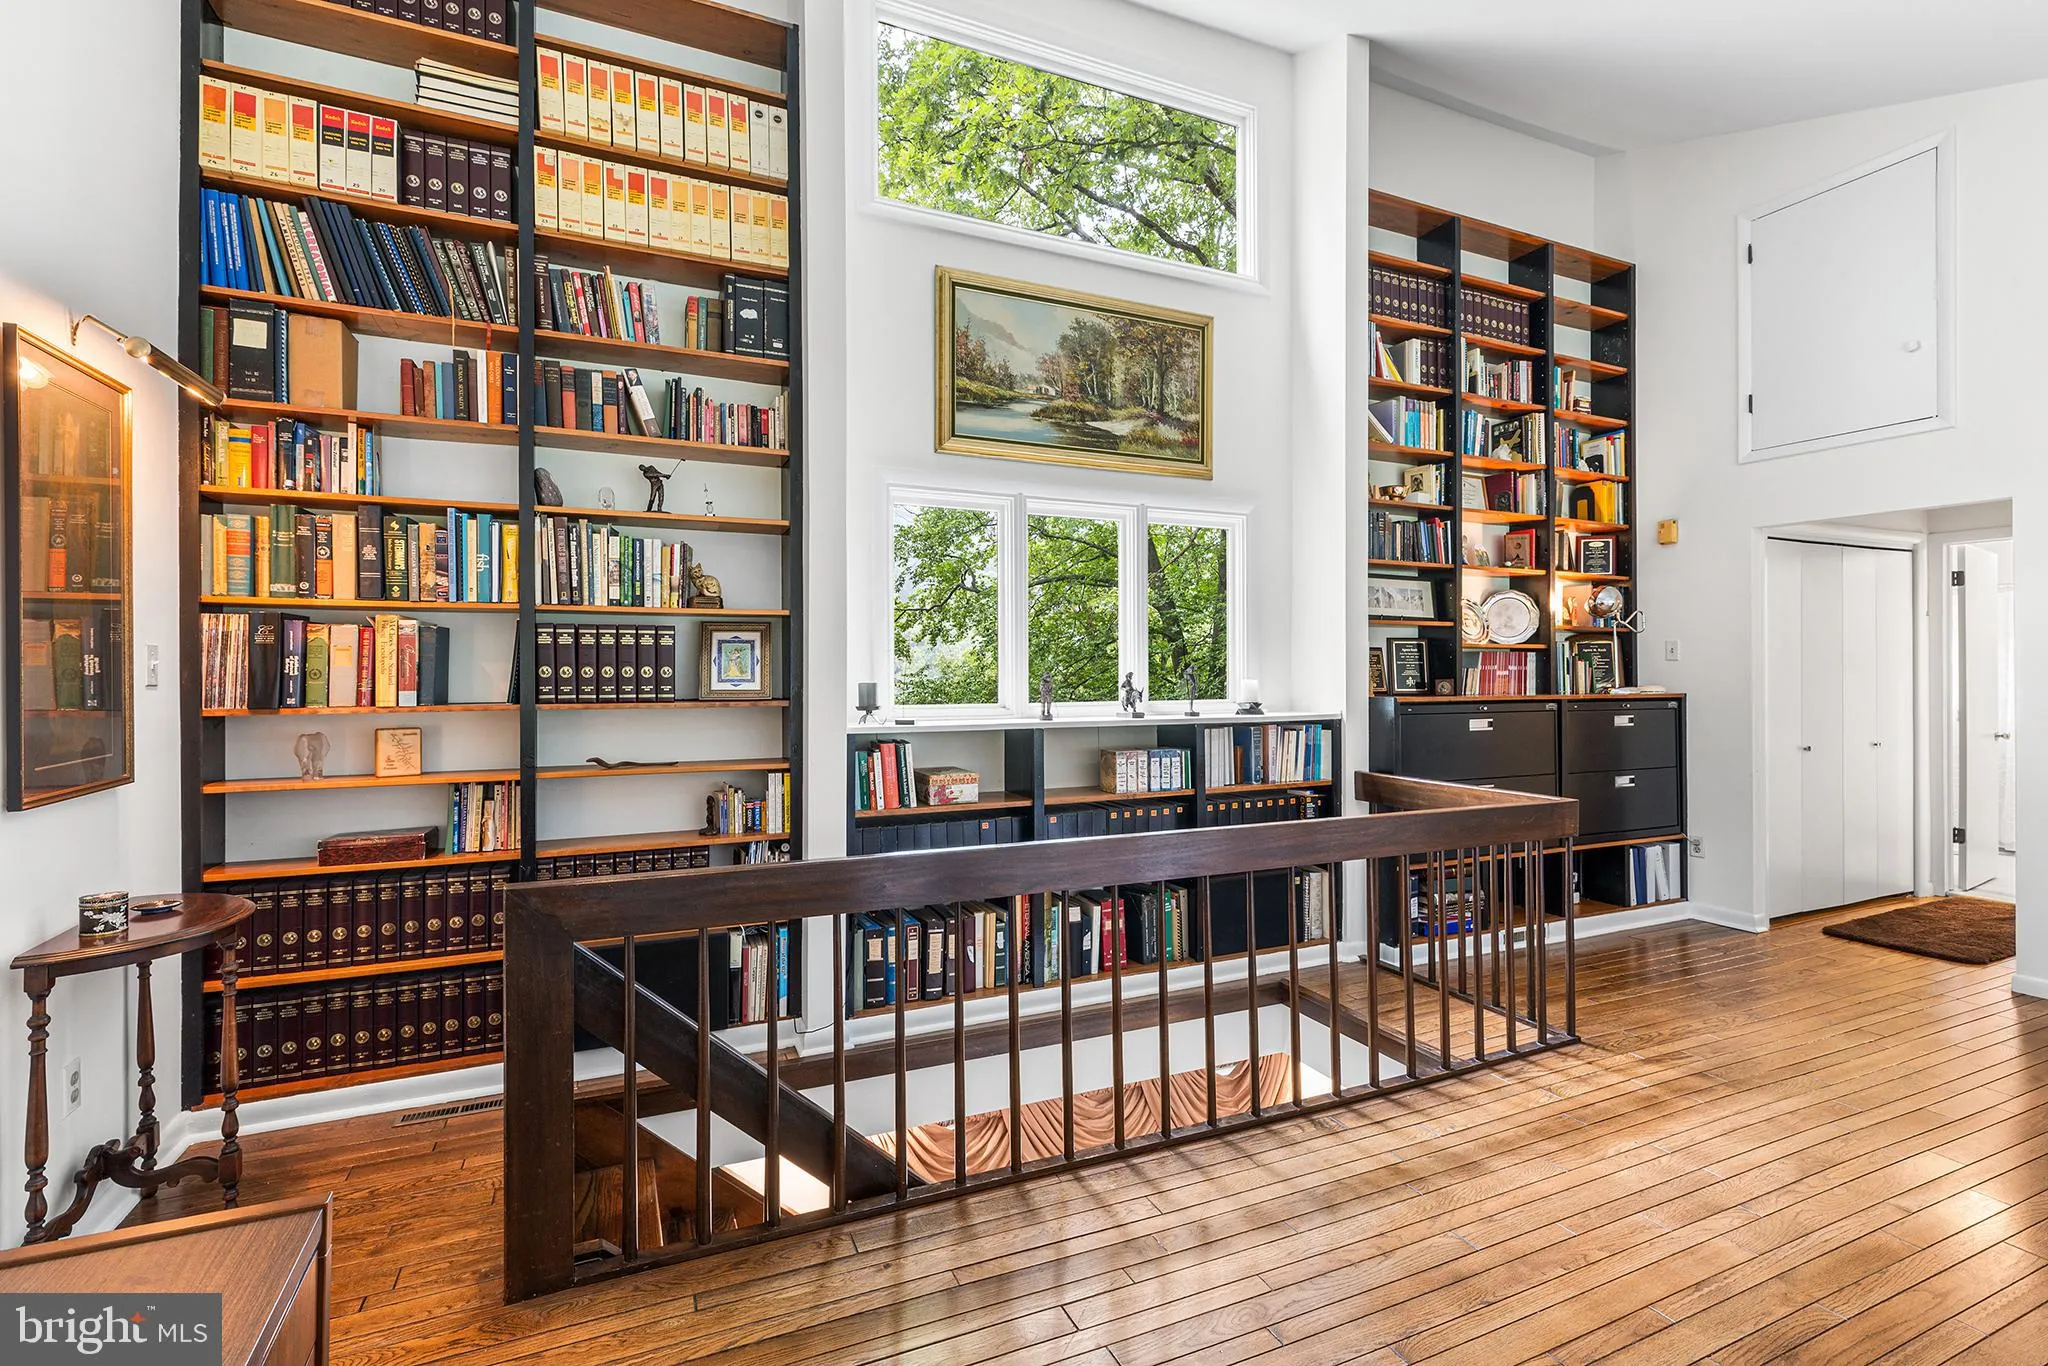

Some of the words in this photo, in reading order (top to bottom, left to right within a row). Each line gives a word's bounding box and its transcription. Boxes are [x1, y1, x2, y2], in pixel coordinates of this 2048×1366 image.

[324, 113, 341, 121] Kodak
[350, 119, 367, 127] Kodak
[375, 124, 392, 132] Kodak
[457, 363, 465, 382] HUMAN
[394, 539, 405, 570] STEDMAN'S
[477, 553, 490, 572] fish
